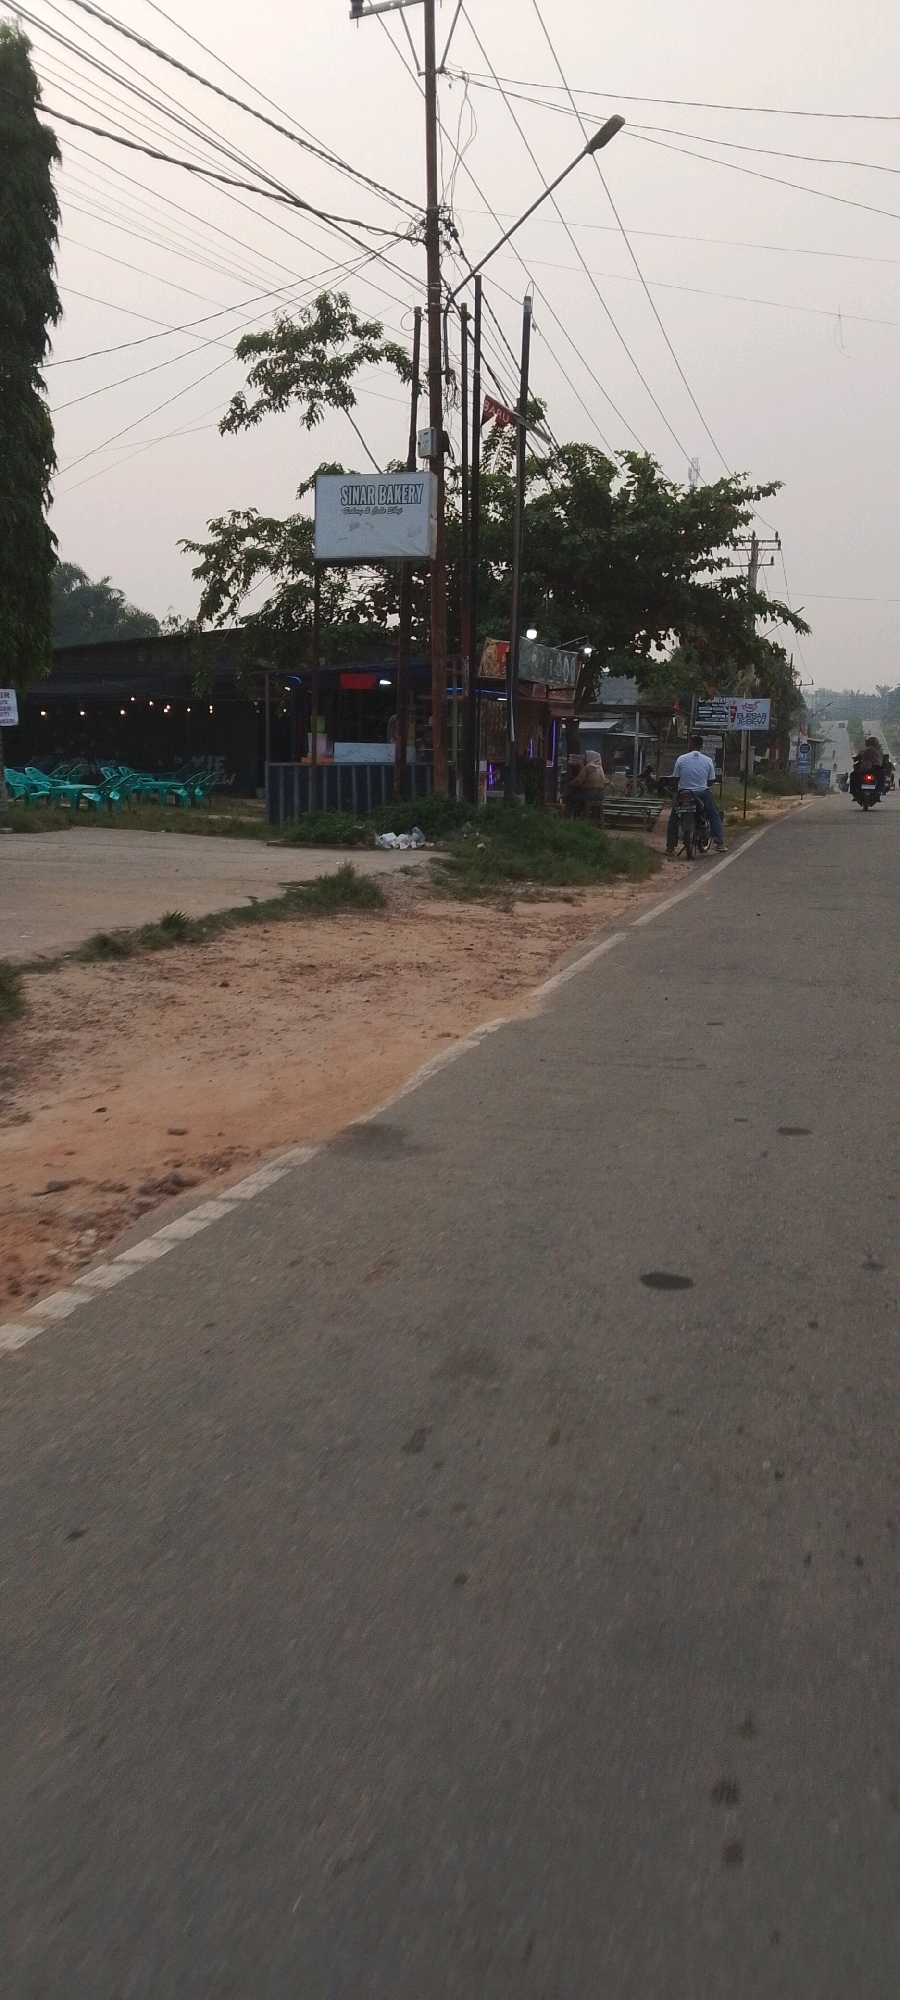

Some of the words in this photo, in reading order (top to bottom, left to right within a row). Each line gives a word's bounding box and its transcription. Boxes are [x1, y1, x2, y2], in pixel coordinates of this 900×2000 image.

[483, 400, 510, 423] BARU
[341, 485, 375, 506] SINAR
[378, 484, 424, 505] BAKERY
